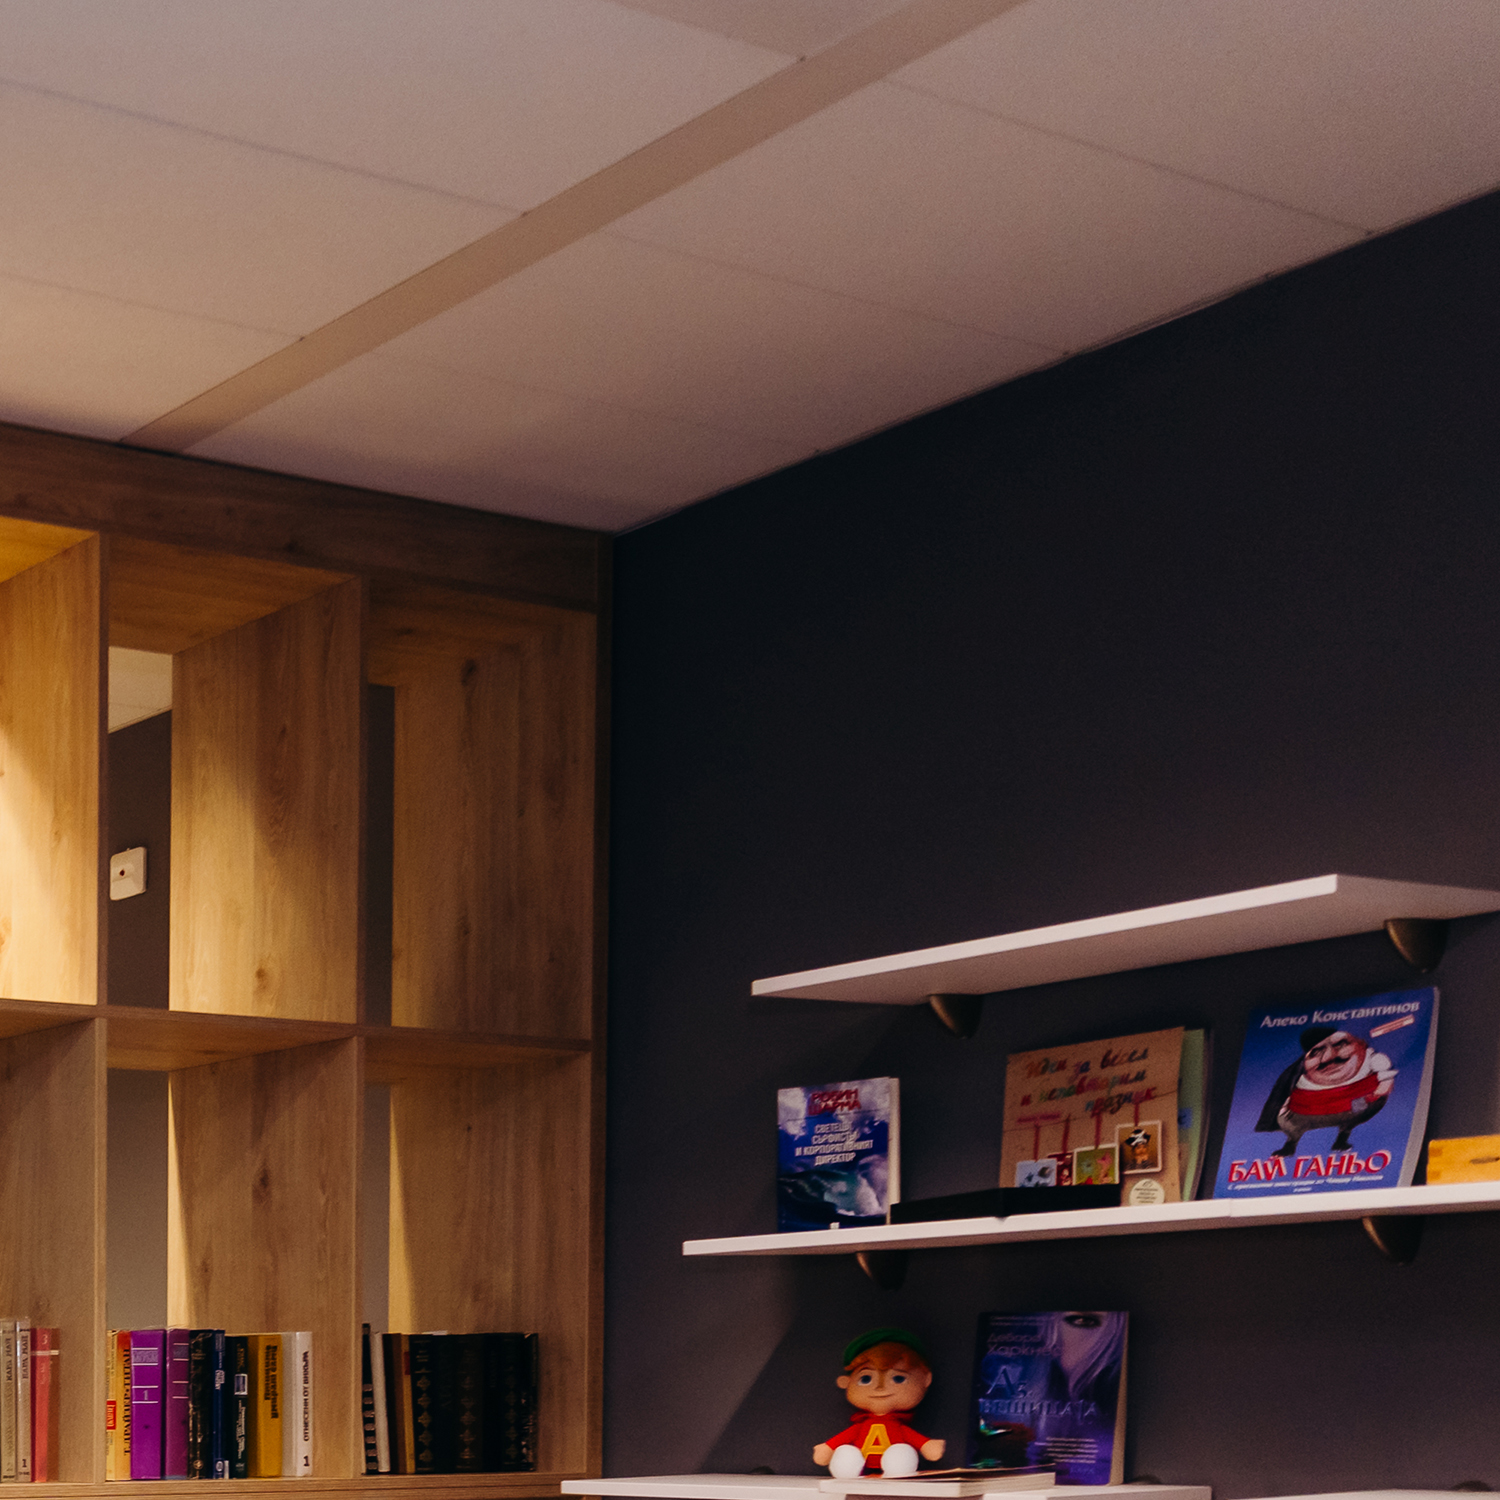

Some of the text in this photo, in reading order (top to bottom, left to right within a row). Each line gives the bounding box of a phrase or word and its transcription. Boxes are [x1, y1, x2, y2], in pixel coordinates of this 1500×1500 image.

[1260, 1001, 1420, 1029] Алеко Константинов
[811, 1088, 859, 1102] РОБИН
[808, 1100, 861, 1116] ШАРМА
[814, 1152, 857, 1166] ДИРЕКТОР
[1227, 1149, 1392, 1183] БАЙ ГАНЬО
[121, 1348, 131, 1386] ТИТАН
[142, 1389, 149, 1401] 1
[302, 1385, 309, 1397] ОТ
[122, 1392, 132, 1444] ДРАЙЗЕР
[861, 1423, 891, 1460] A
[21, 1459, 27, 1468] 1
